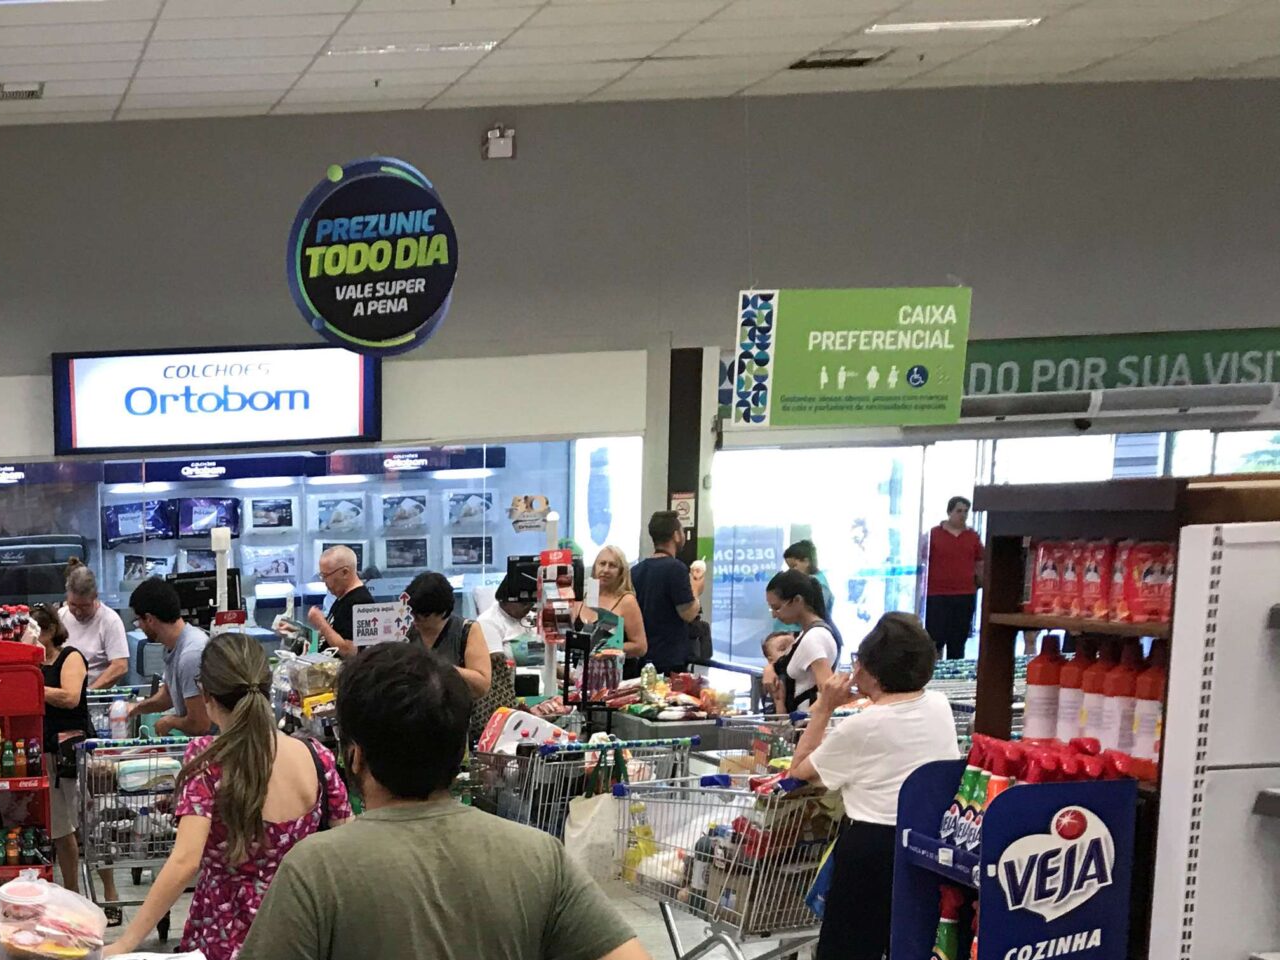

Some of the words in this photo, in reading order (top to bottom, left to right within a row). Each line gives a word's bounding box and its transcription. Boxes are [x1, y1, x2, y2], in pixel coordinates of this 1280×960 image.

[315, 208, 437, 243] PREZUNIC
[306, 240, 393, 278] TODO
[394, 234, 449, 269] DIA
[336, 283, 373, 301] VALE
[375, 278, 426, 297] SUPER
[353, 304, 365, 317] A
[367, 297, 409, 315] PENA
[899, 305, 956, 324] CAIXA
[808, 330, 954, 351] PREFERENCIAL
[970, 361, 1020, 395] DO
[1031, 357, 1108, 392] POR
[1117, 353, 1192, 388] SUA
[125, 385, 310, 415] Ortobom
[181, 465, 226, 475] Ortobom
[383, 457, 428, 467] Ortobom
[357, 620, 370, 628] SEM
[357, 628, 378, 637] PARAR
[1004, 838, 1112, 907] VEJA
